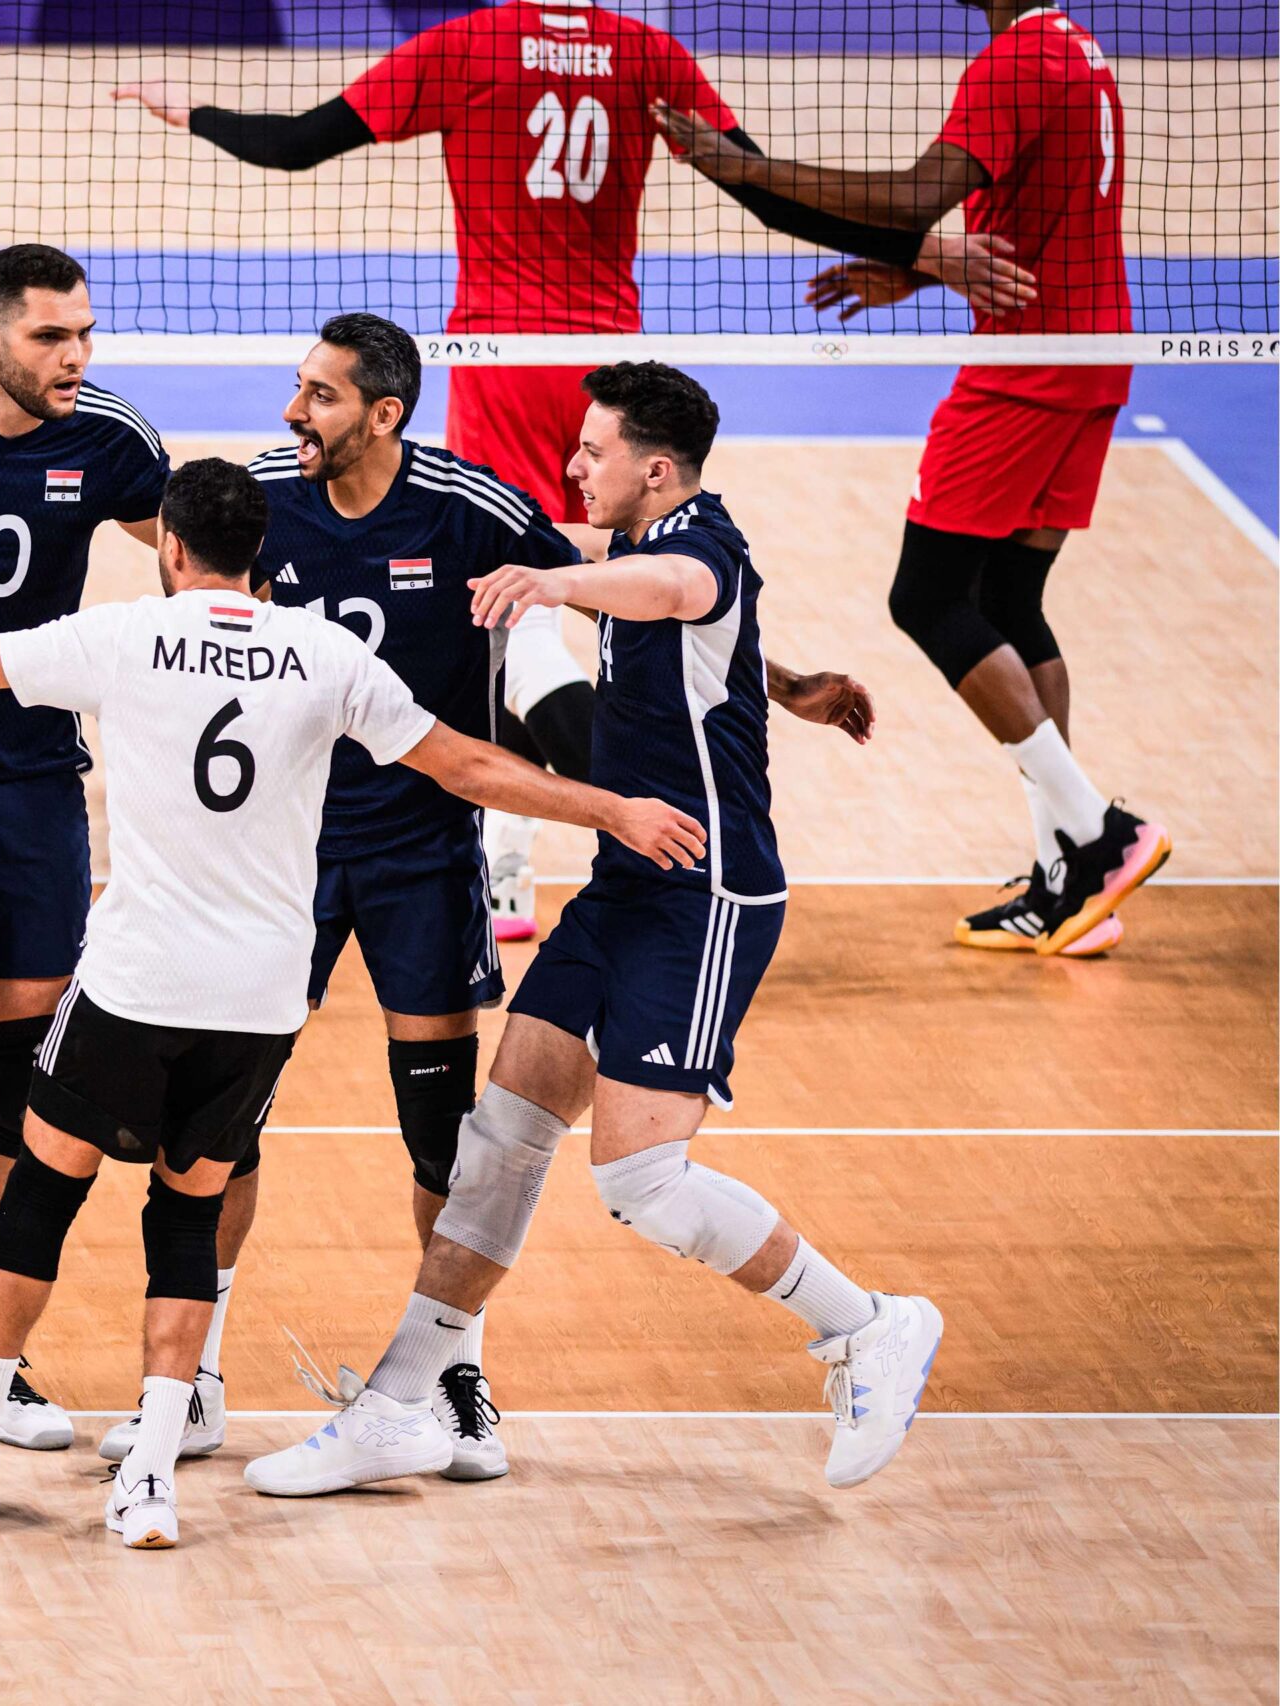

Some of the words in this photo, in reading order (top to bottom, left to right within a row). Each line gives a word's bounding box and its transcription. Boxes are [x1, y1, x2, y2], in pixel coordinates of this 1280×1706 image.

[521, 35, 614, 77] BIENIEK
[525, 91, 610, 203] 20
[393, 580, 431, 589] EGY
[152, 635, 308, 682] M.REDA
[193, 697, 256, 813] 6
